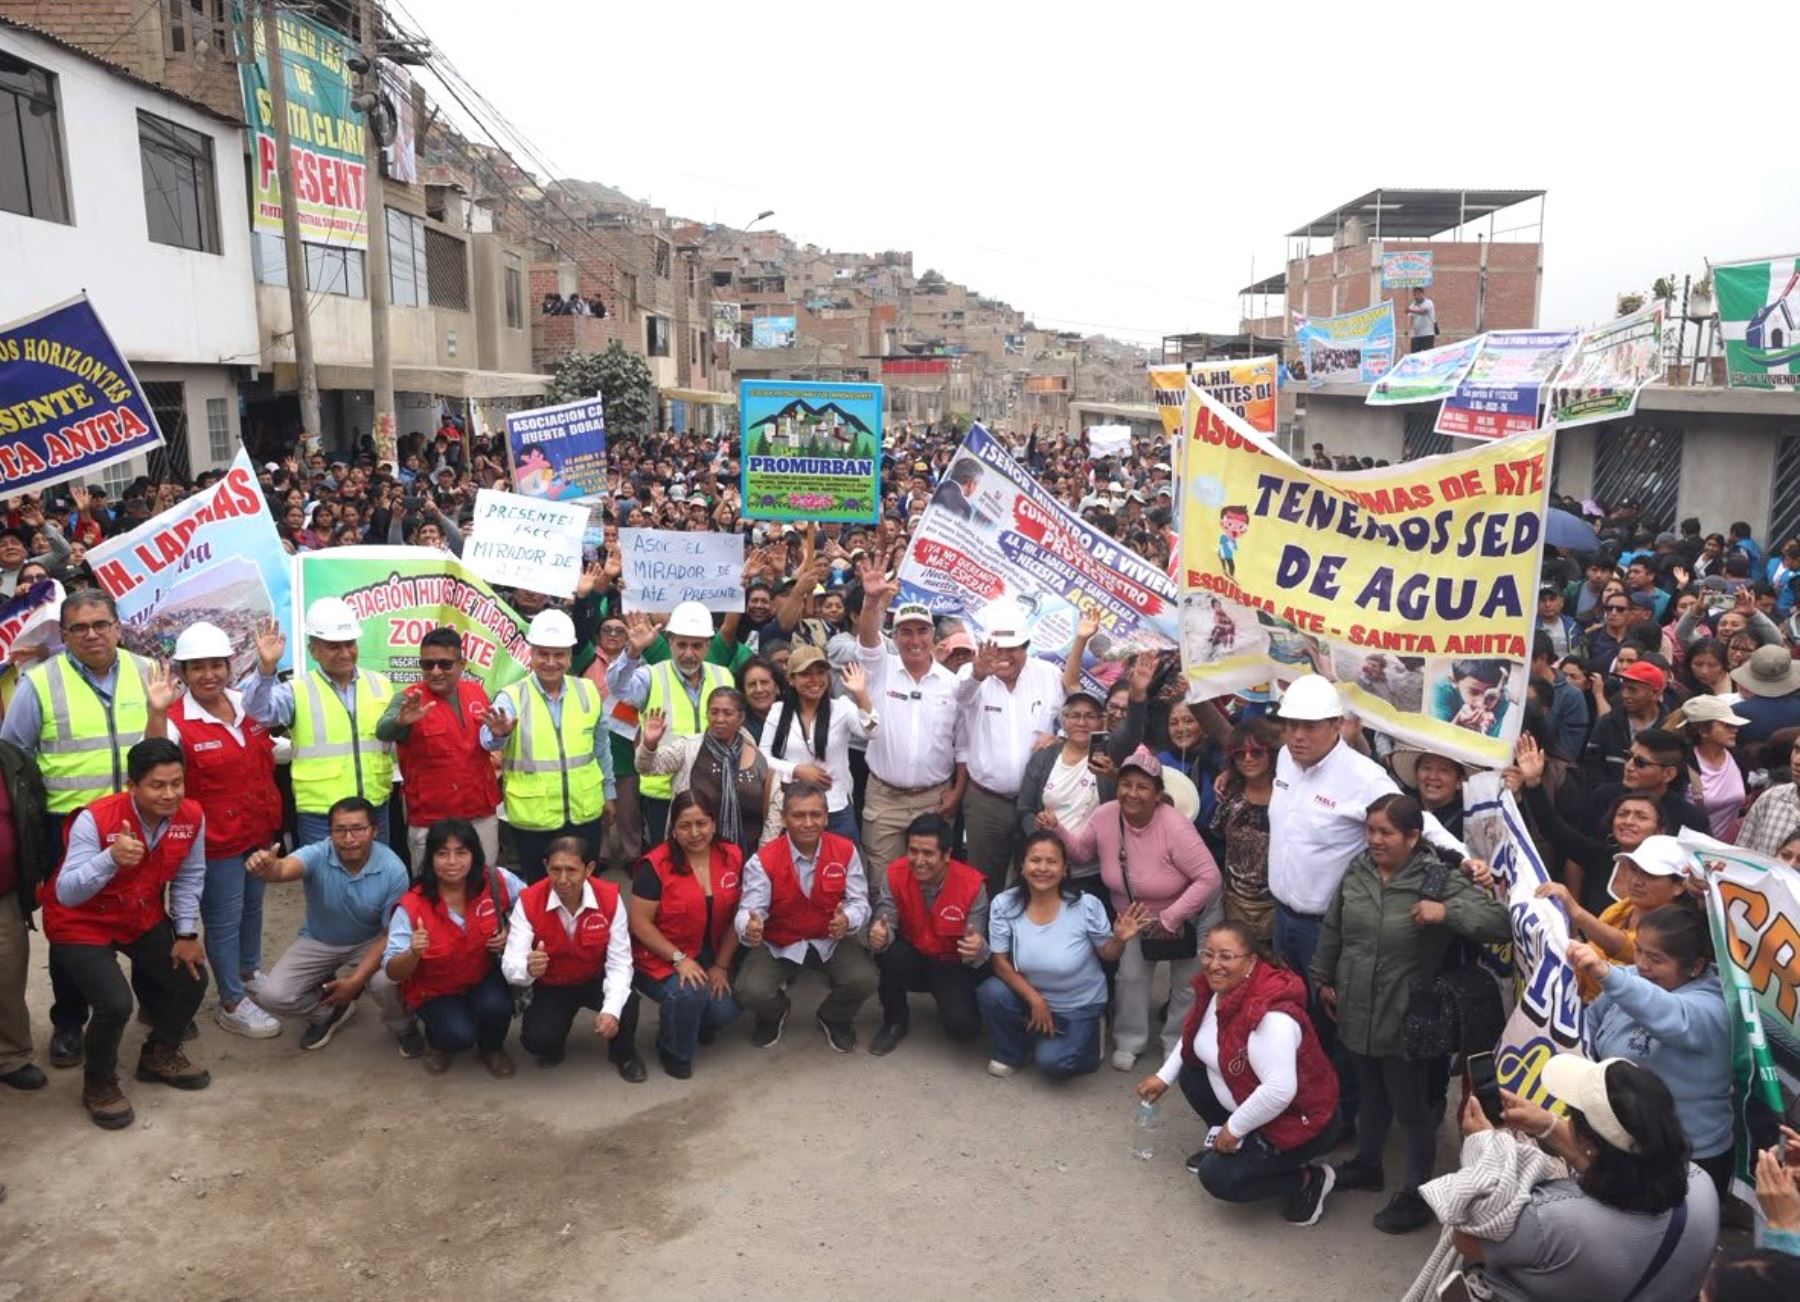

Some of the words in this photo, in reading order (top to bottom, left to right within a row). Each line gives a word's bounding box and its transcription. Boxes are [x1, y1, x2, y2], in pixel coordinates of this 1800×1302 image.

[293, 63, 315, 96] DE
[256, 86, 312, 142] STA
[257, 133, 368, 213] PESENT
[24, 338, 132, 404] HORIZONTES
[1191, 370, 1234, 387] A.HH.
[0, 383, 95, 436] SENTE
[512, 409, 586, 433] ASOCIACION
[521, 427, 566, 445] HUERTA
[0, 442, 46, 483] TA
[44, 406, 149, 468] ANITA
[748, 456, 874, 476] PROMURBAN
[1438, 469, 1486, 503] DE
[1494, 453, 1546, 496] ATE
[135, 467, 262, 574] LADAS
[1254, 474, 1453, 556] TENEMOS
[1457, 511, 1541, 558] SED
[473, 541, 546, 565] MIRADOR
[551, 553, 576, 568] DE
[633, 560, 705, 580] MIRADOR
[715, 564, 733, 577] DE
[1032, 487, 1092, 549] MINISTRO
[1092, 542, 1118, 567] DE
[1118, 556, 1180, 600] VIVIEN
[1041, 530, 1115, 592] PROYECTO
[1015, 553, 1067, 593] NECESITA
[1039, 549, 1076, 580] LADERAS
[1085, 582, 1110, 607] SANTA
[1110, 600, 1136, 623] CLARA
[1276, 544, 1347, 601] DE
[1354, 565, 1523, 621] AGUA
[454, 582, 478, 616] DE
[473, 596, 516, 649] TÚPAC
[1348, 624, 1436, 654] SANTA
[1444, 632, 1527, 658] ANITA
